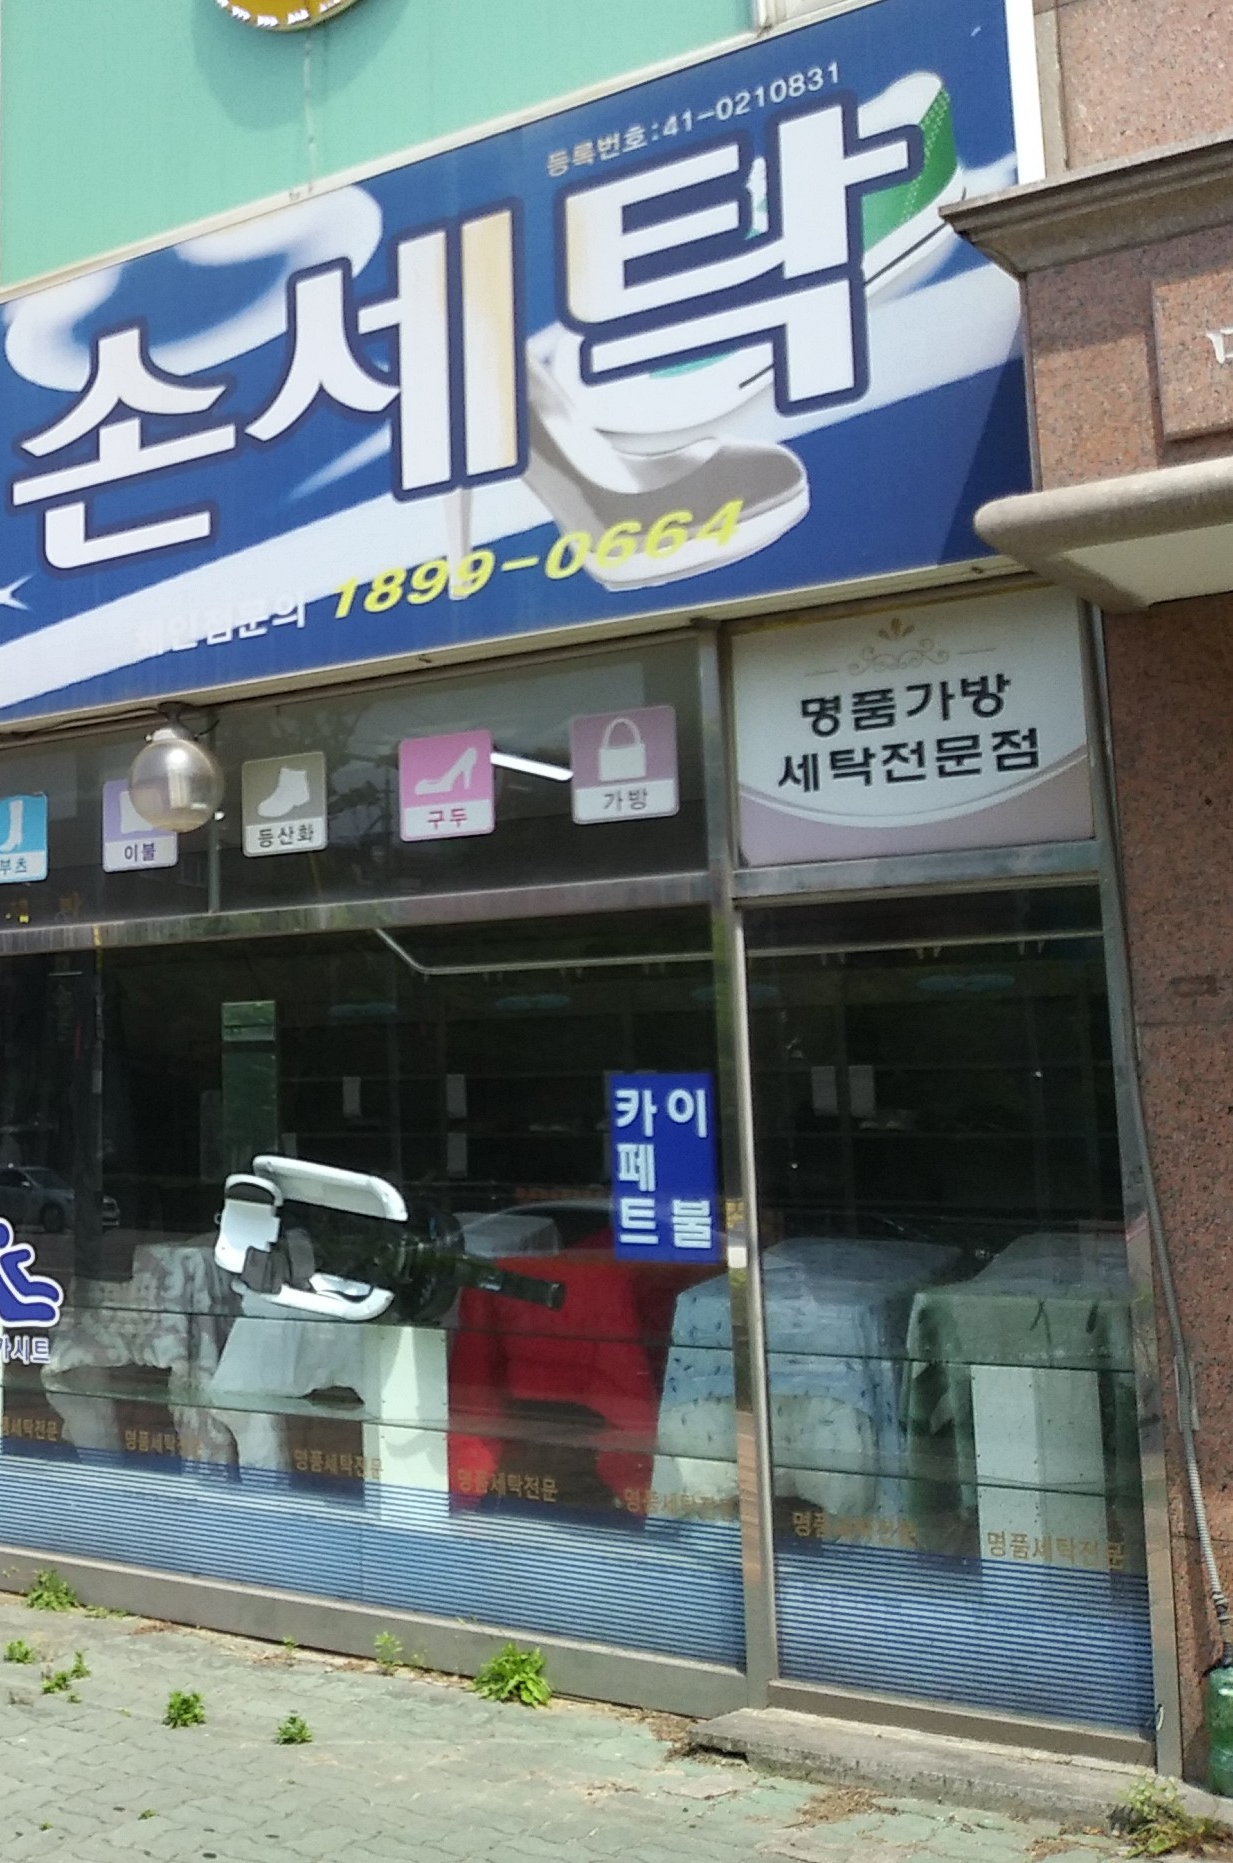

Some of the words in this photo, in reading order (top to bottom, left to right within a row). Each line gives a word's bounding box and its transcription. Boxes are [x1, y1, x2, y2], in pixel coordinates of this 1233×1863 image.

[12, 100, 913, 572] 손세탁
[332, 502, 745, 618] 1899-0664
[799, 673, 1012, 736] 명품가방
[777, 727, 1041, 792] 세탁전문점
[426, 808, 467, 831] 구두
[602, 784, 649, 813] 가방
[123, 841, 157, 864] 이불
[256, 823, 315, 848] 등산화
[615, 1088, 659, 1247] 카페트
[667, 1088, 715, 1250] 이불
[294, 1449, 383, 1480] 명품세탁전문
[457, 1469, 559, 1503] 명품세탁전문
